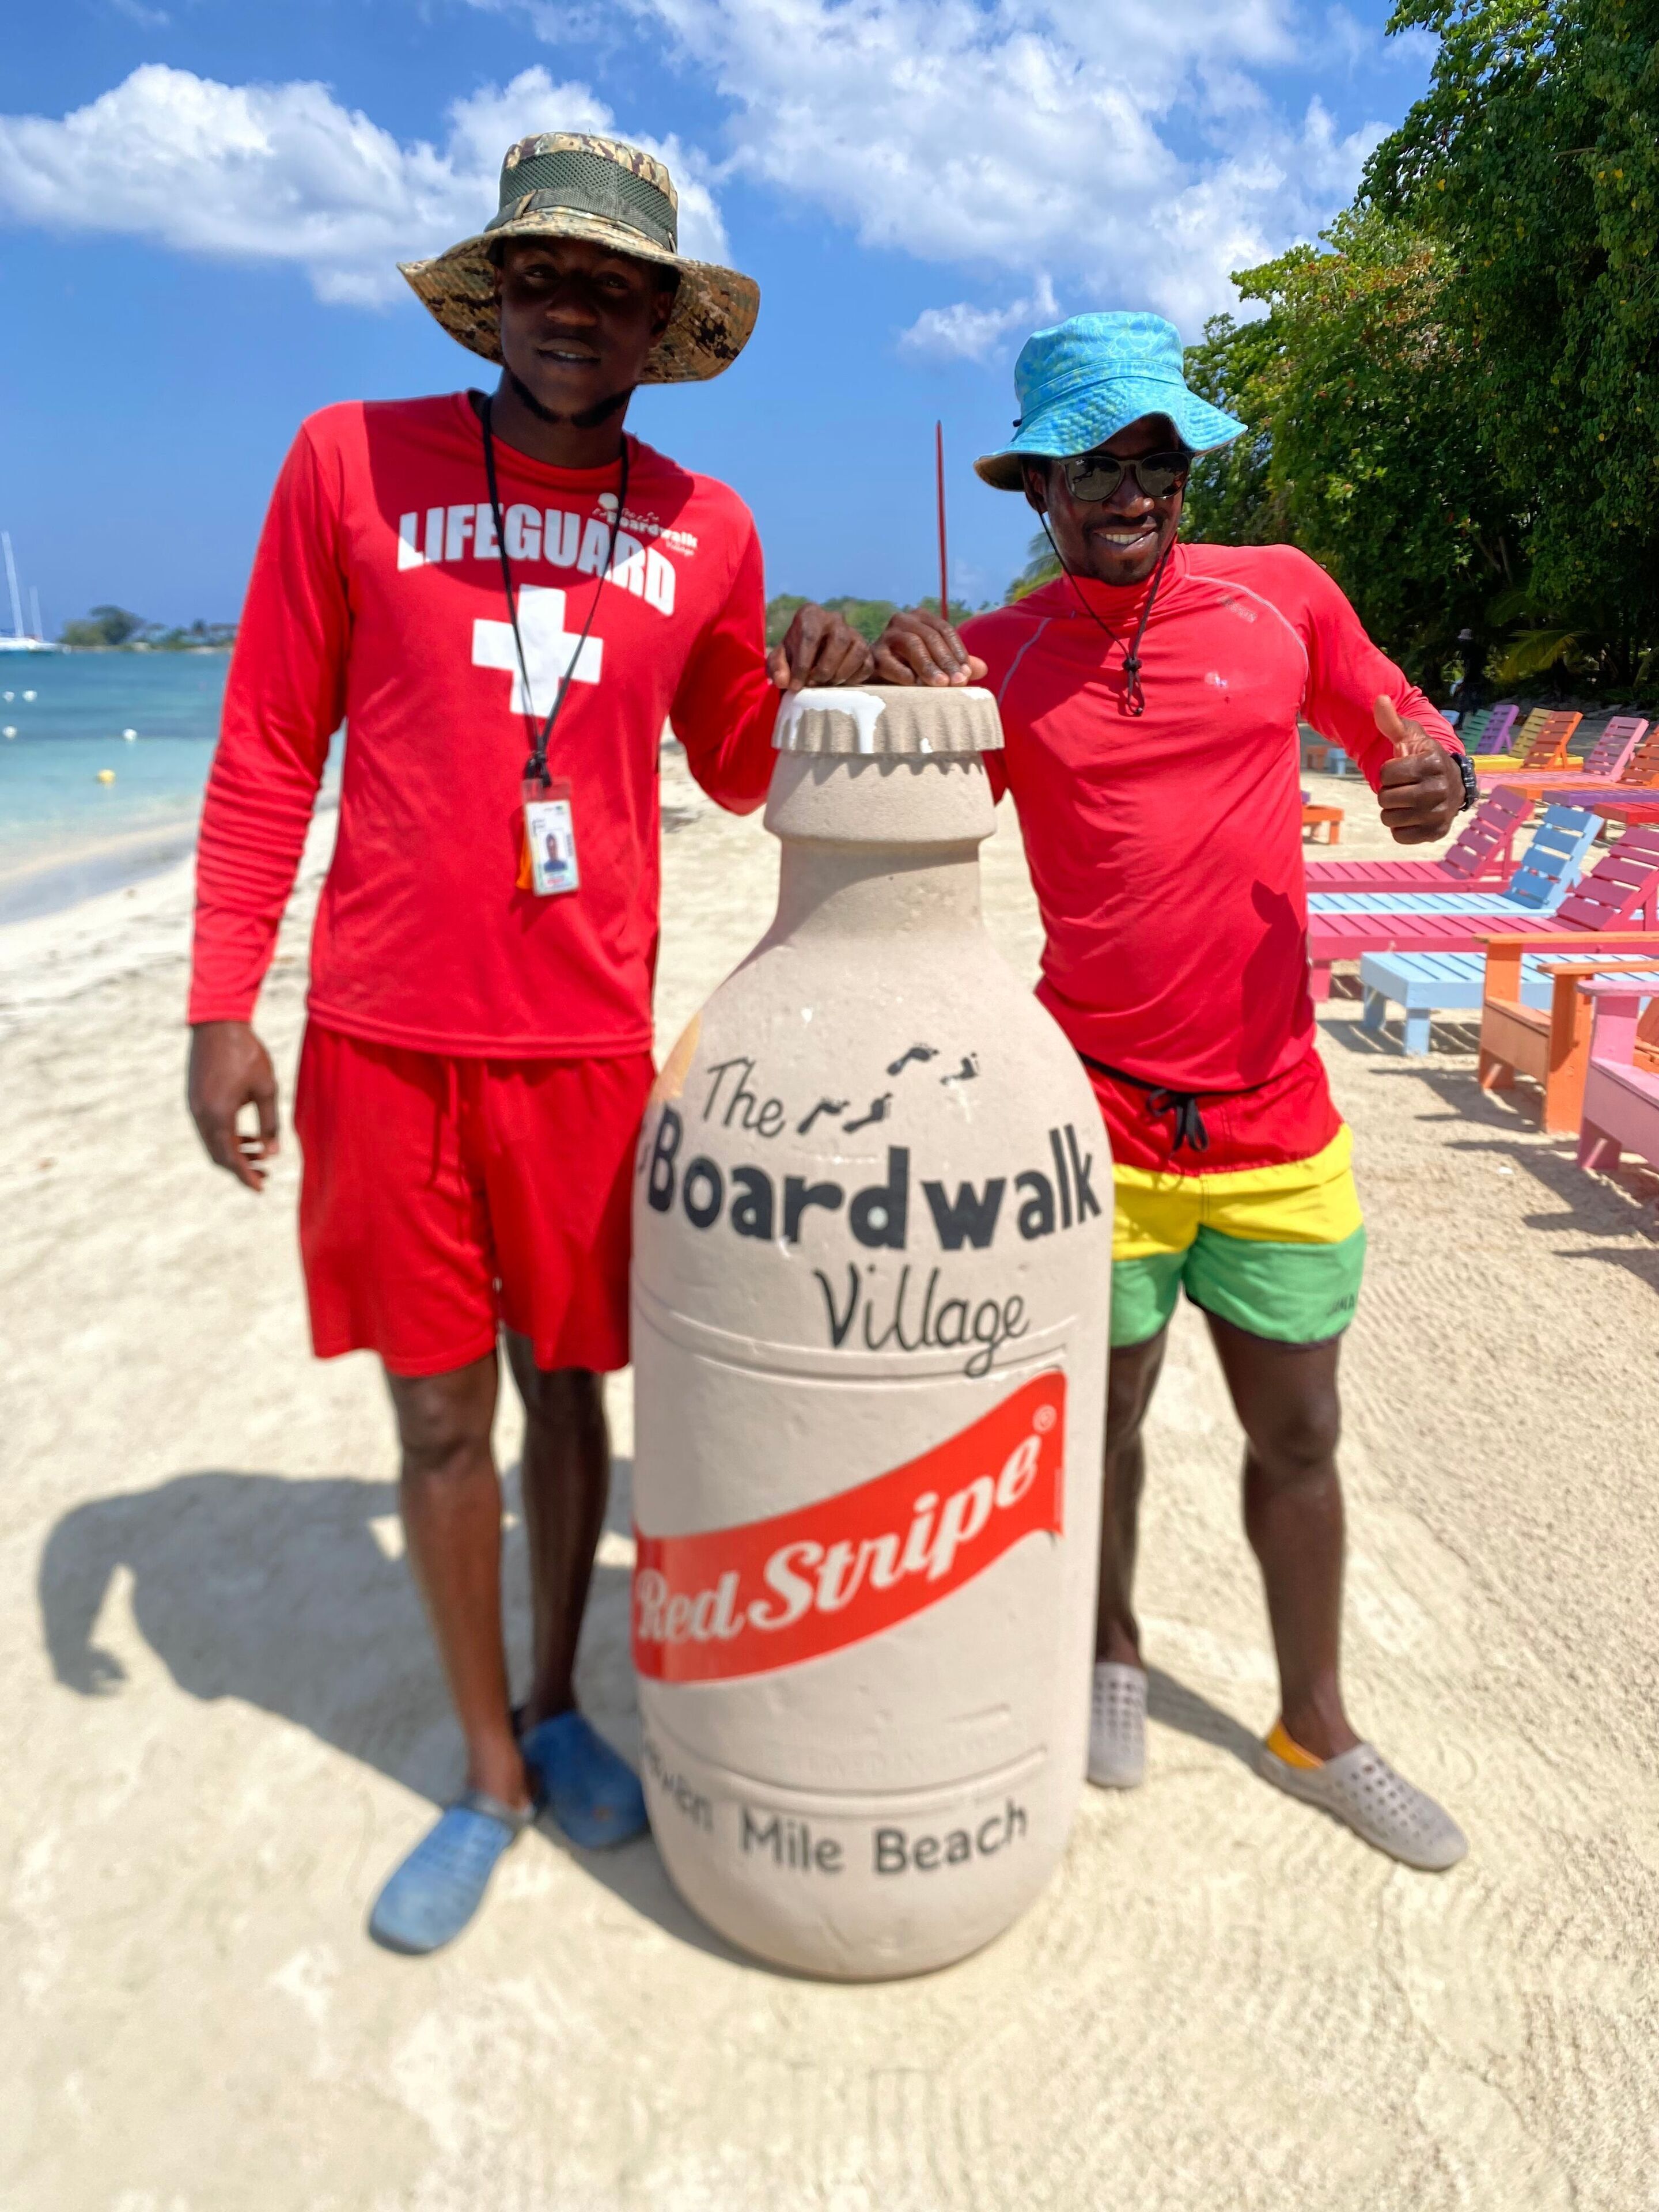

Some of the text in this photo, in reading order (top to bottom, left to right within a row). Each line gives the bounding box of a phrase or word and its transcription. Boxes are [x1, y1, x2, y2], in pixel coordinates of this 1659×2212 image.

[398, 503, 676, 616] LIFEGUARD
[701, 1056, 786, 1138] The
[648, 1103, 1103, 1251] Boardwalk
[813, 1262, 1030, 1377] Village
[637, 1434, 1043, 1645] Red Stripe
[740, 1806, 843, 1876] Mile
[874, 1796, 1028, 1876] Beach
